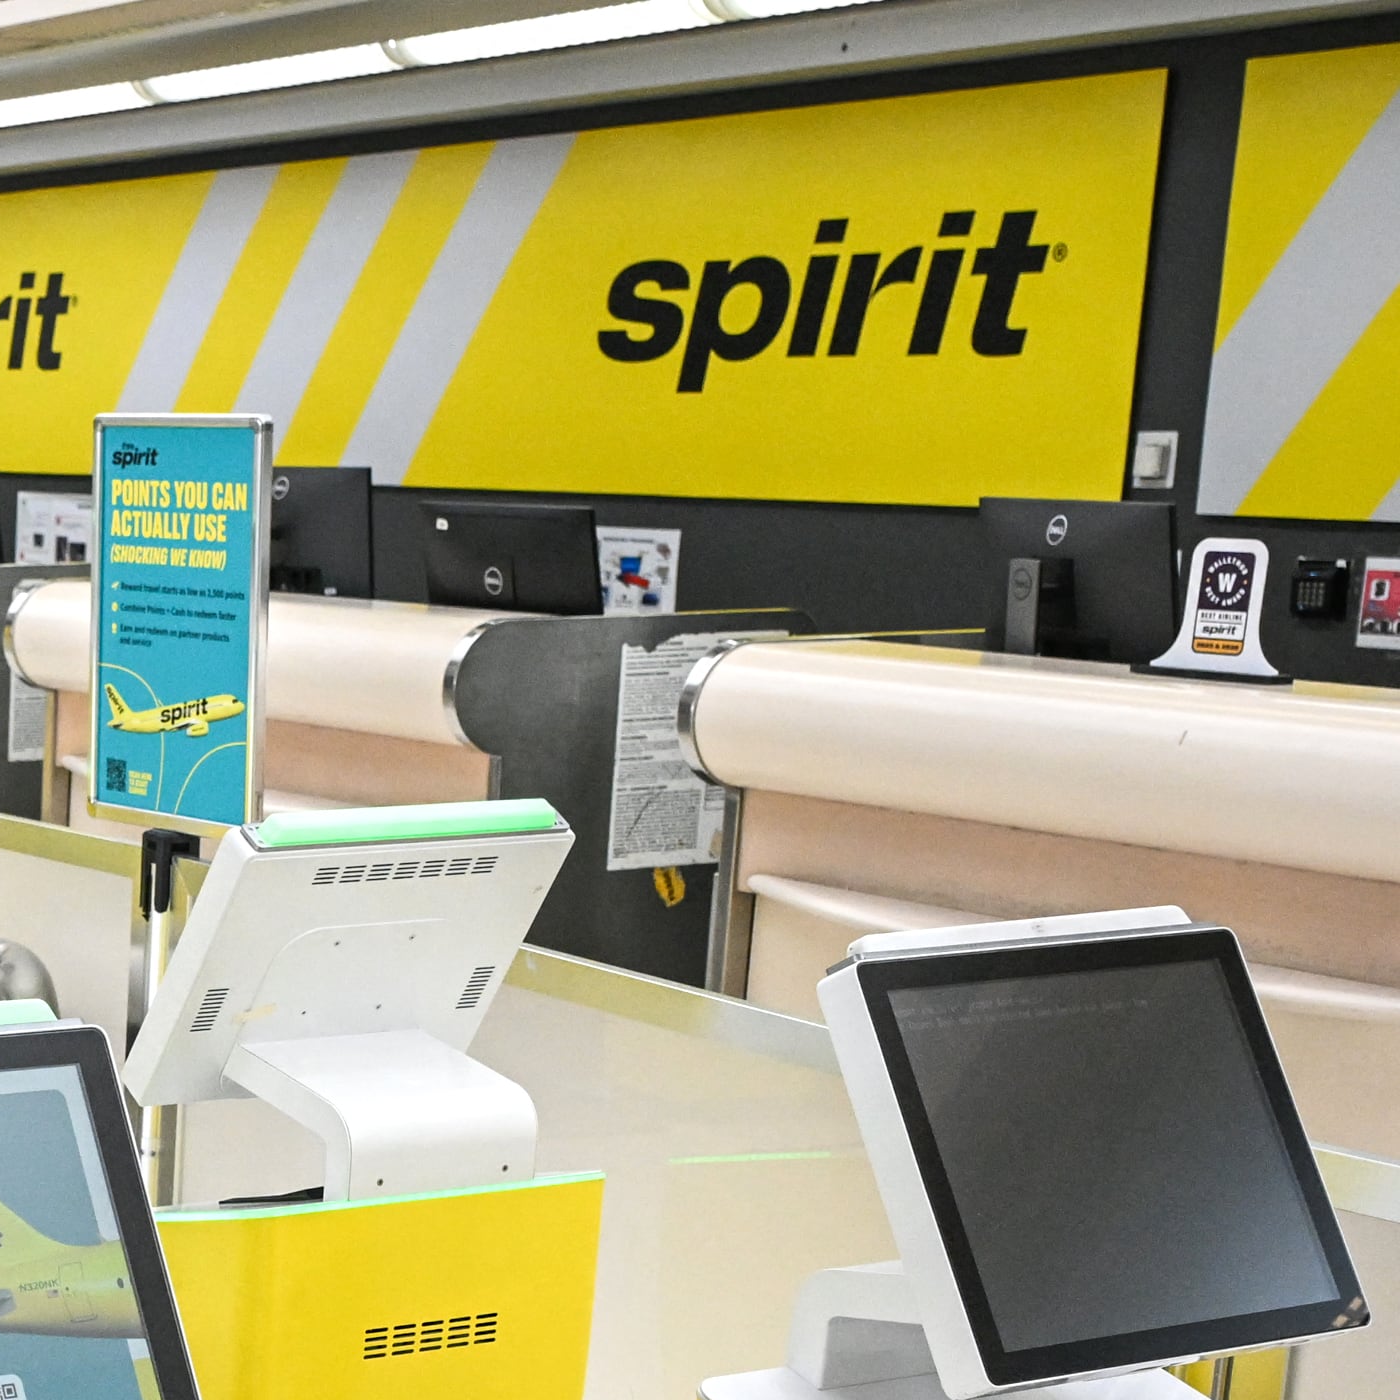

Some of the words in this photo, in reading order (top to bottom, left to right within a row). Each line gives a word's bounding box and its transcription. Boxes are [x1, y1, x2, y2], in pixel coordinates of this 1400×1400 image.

[596, 209, 1051, 394] spirit
[112, 447, 158, 469] spirit
[112, 479, 171, 508] POINTS
[174, 481, 208, 509] YOU
[212, 482, 248, 511] CAN
[111, 509, 190, 540] ACTUALLY
[194, 513, 227, 542] USE
[110, 543, 168, 566] (SHOCKING
[171, 547, 187, 566] WE
[189, 549, 226, 571] KNOW)
[1218, 572, 1237, 593] W
[225, 591, 245, 600] points
[1202, 624, 1236, 635] spirit
[160, 698, 208, 725] spirit
[19, 1278, 59, 1293] N320NK
